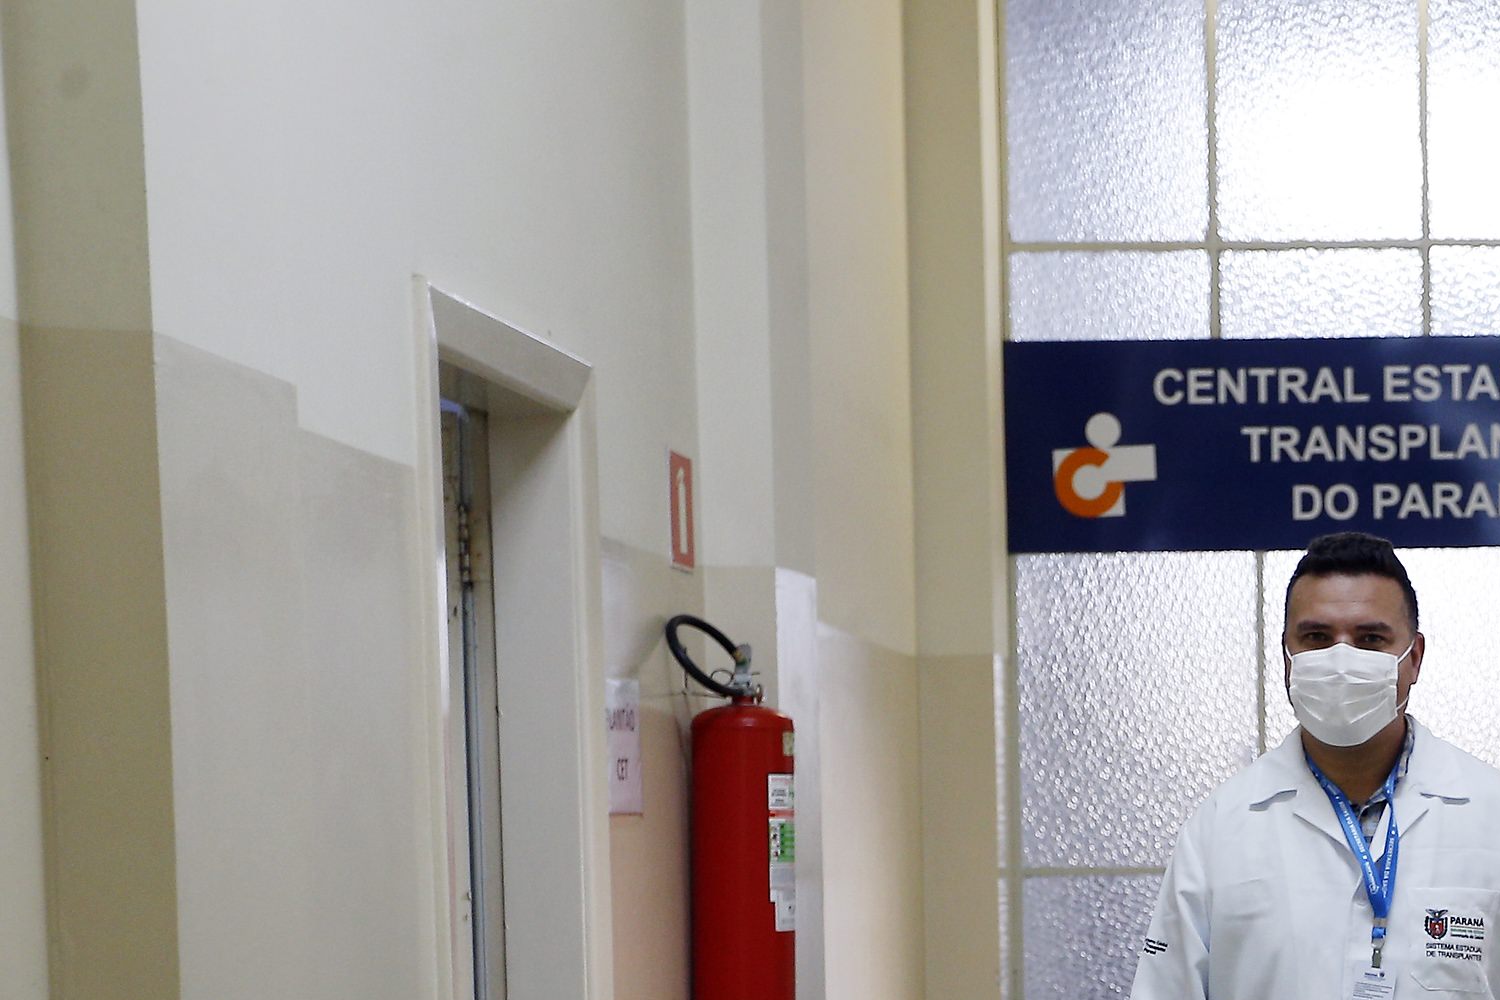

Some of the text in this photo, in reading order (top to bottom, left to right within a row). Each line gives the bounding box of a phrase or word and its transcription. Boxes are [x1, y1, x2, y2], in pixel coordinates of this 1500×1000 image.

[1153, 366, 1371, 405] CENTRAL
[1291, 483, 1360, 521] DO
[1450, 915, 1484, 928] PARANÁ
